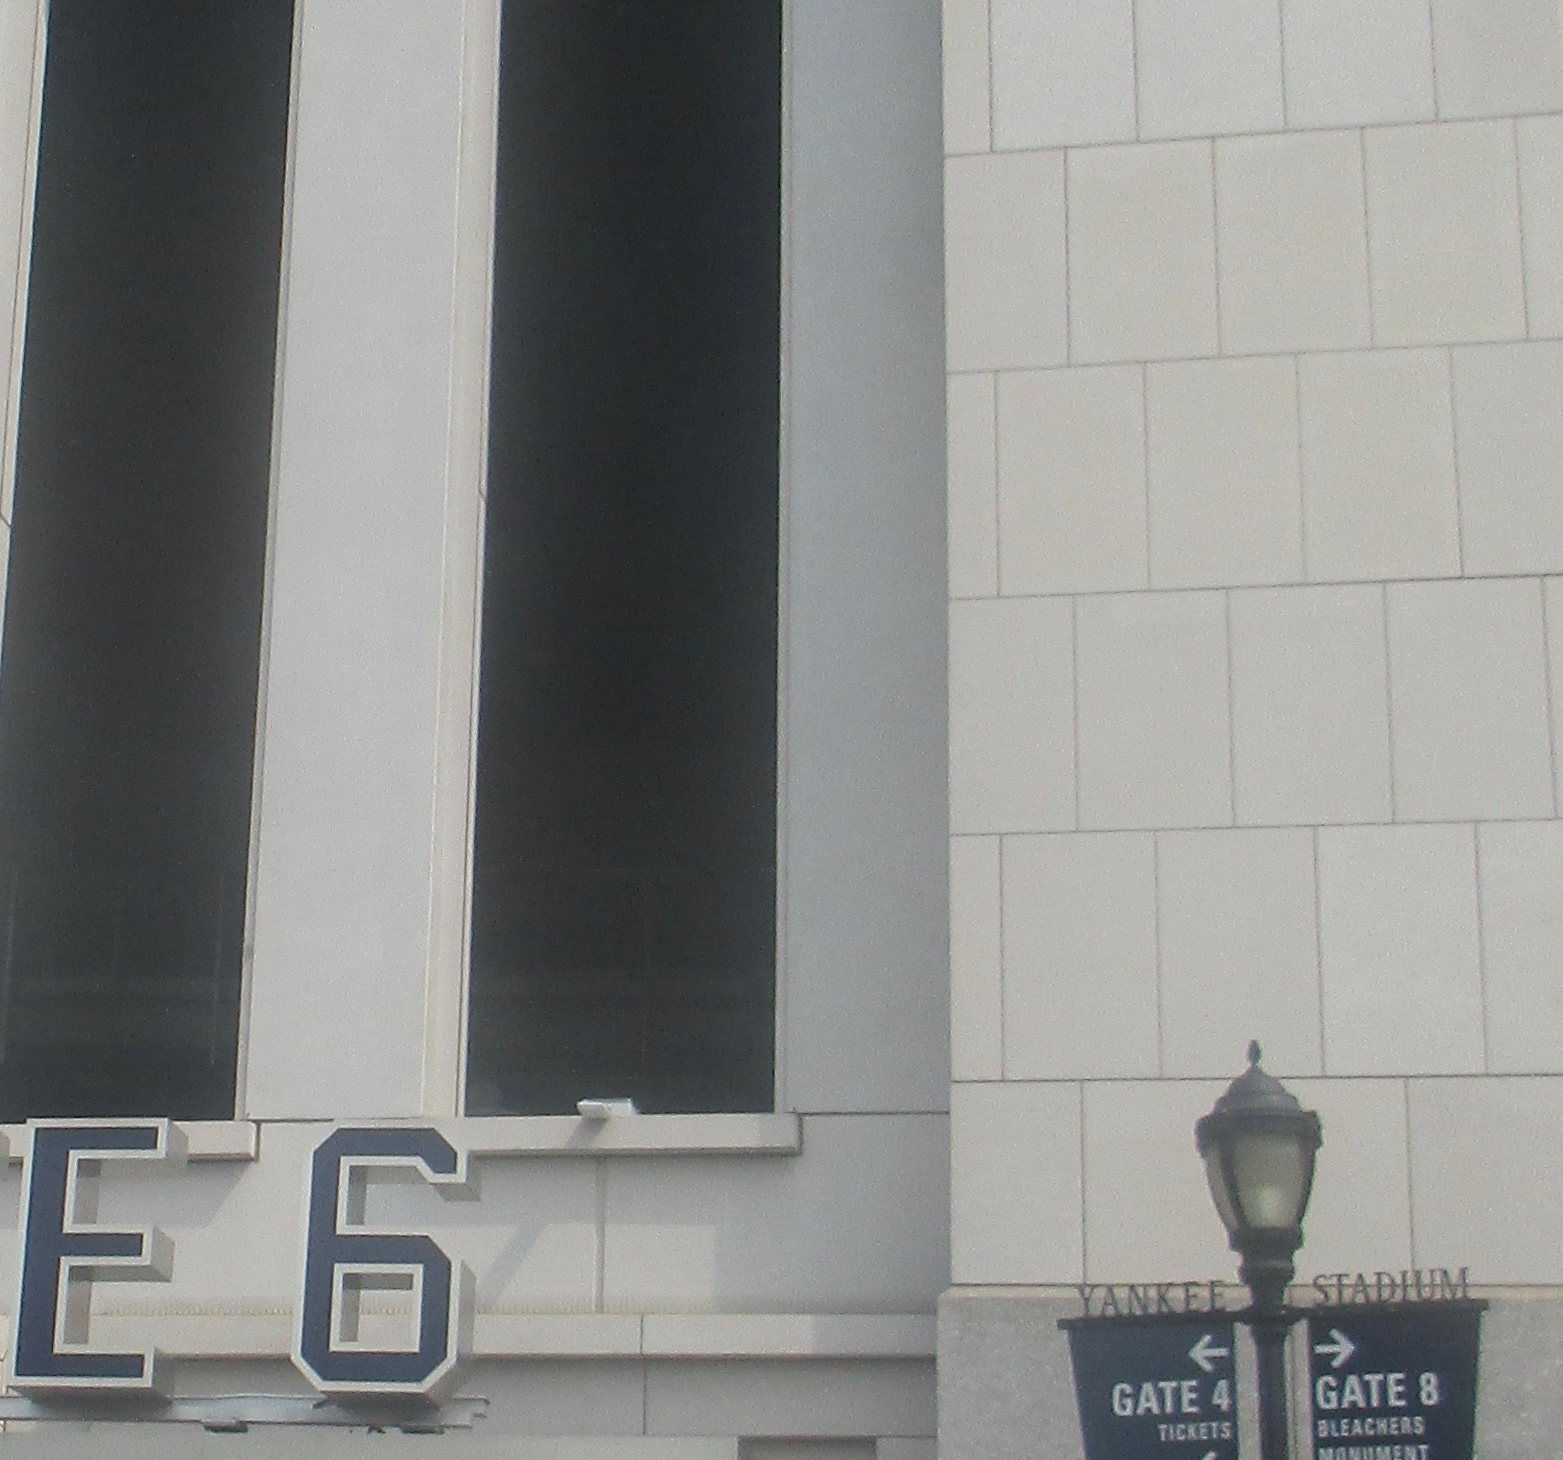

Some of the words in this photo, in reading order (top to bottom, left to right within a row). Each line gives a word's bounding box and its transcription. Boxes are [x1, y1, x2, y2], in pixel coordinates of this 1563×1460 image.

[288, 1125, 472, 1395] 6
[1075, 1279, 1225, 1317] YANKEE
[1313, 1266, 1468, 1305] STADIUM
[1112, 1379, 1200, 1417] GATE
[1211, 1378, 1233, 1413] 4
[1315, 1372, 1407, 1410] GATE
[1419, 1371, 1440, 1406] 8
[1157, 1421, 1232, 1442] TICKETS
[1317, 1415, 1426, 1437] BLEACHERS
